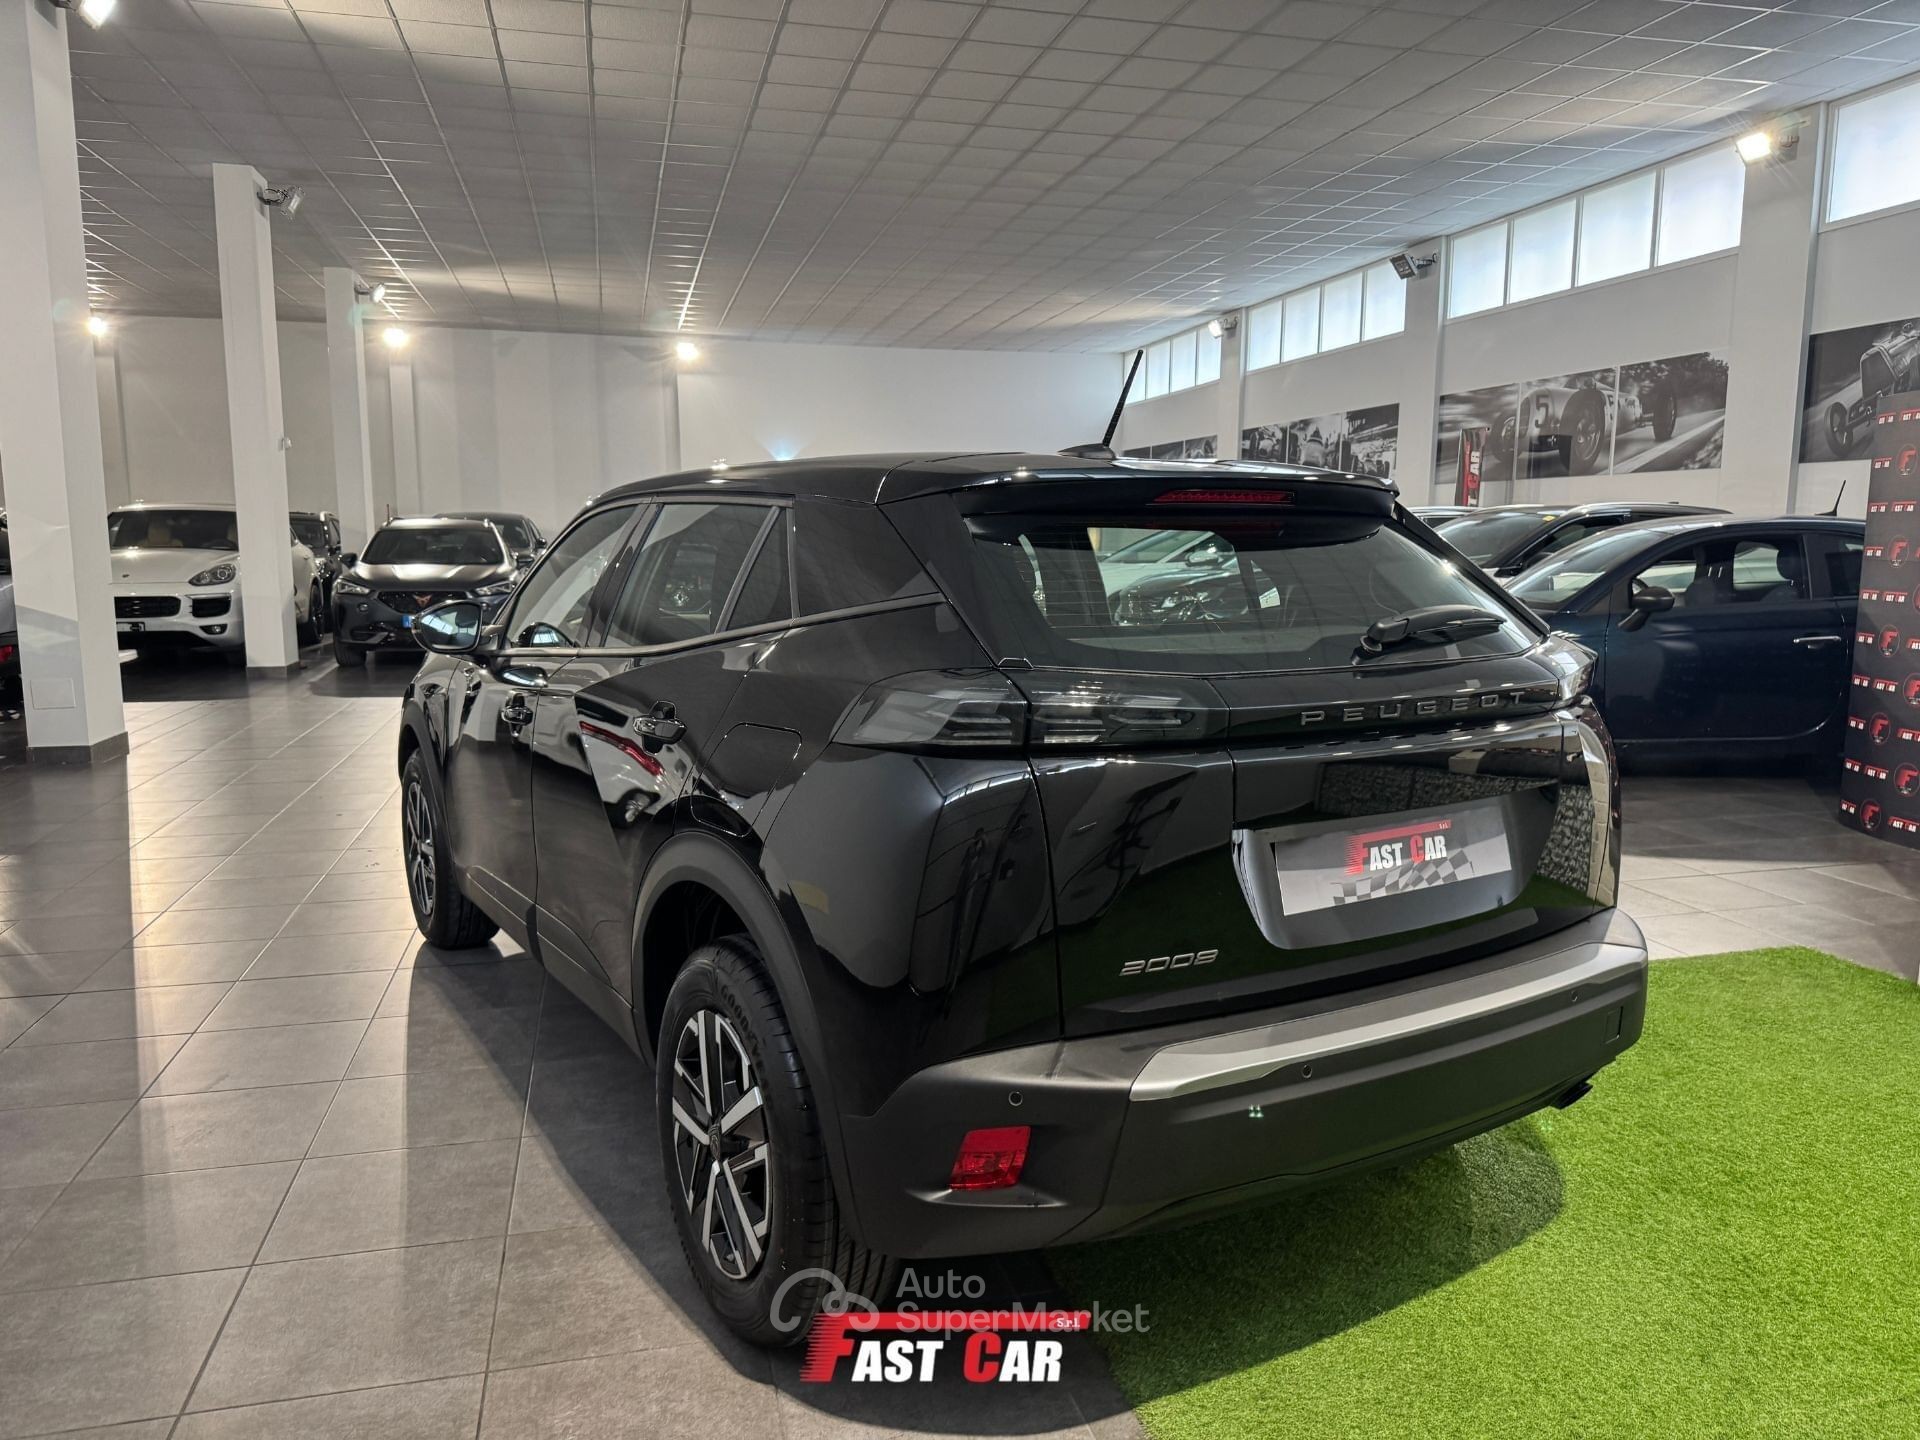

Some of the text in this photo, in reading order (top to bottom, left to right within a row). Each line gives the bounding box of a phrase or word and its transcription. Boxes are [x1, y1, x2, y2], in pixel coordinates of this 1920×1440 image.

[1301, 691, 1526, 727] PEUGEOT
[1344, 829, 1448, 878] FAST CAR
[1119, 949, 1219, 977] 2008
